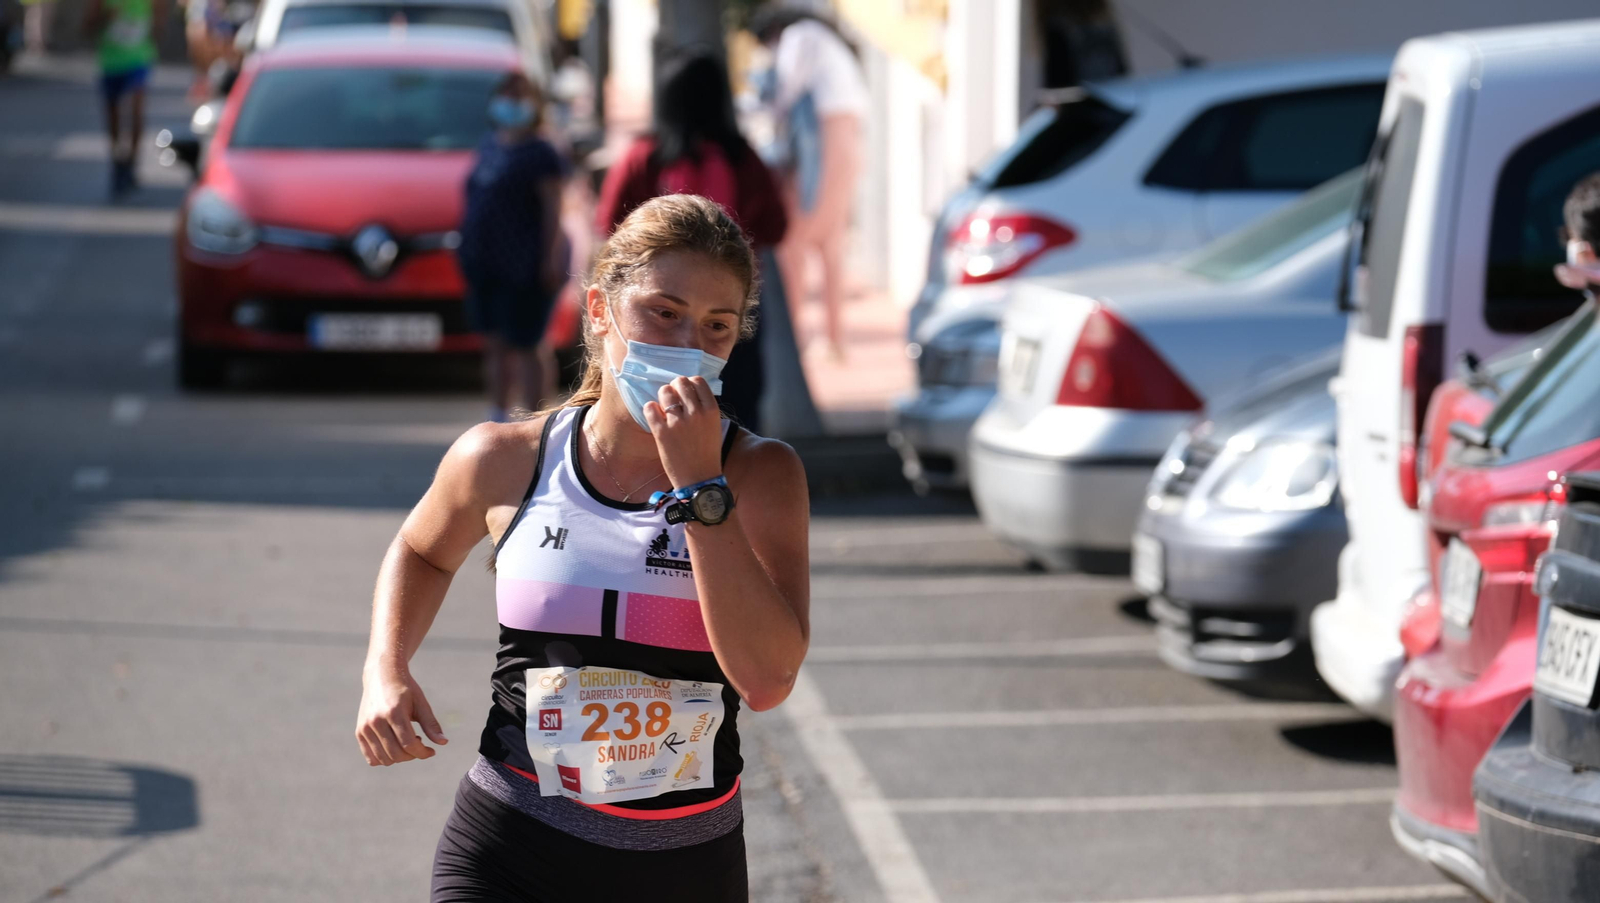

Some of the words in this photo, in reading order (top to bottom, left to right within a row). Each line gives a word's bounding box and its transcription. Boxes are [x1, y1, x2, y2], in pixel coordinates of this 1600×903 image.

[579, 671, 637, 688] CIRCUITO
[579, 688, 624, 701] CARRERAS
[626, 688, 673, 700] POPULARES
[542, 713, 559, 728] SN
[580, 701, 672, 742] 238
[689, 712, 709, 742] RIOJA
[598, 741, 656, 763] SANDRA
